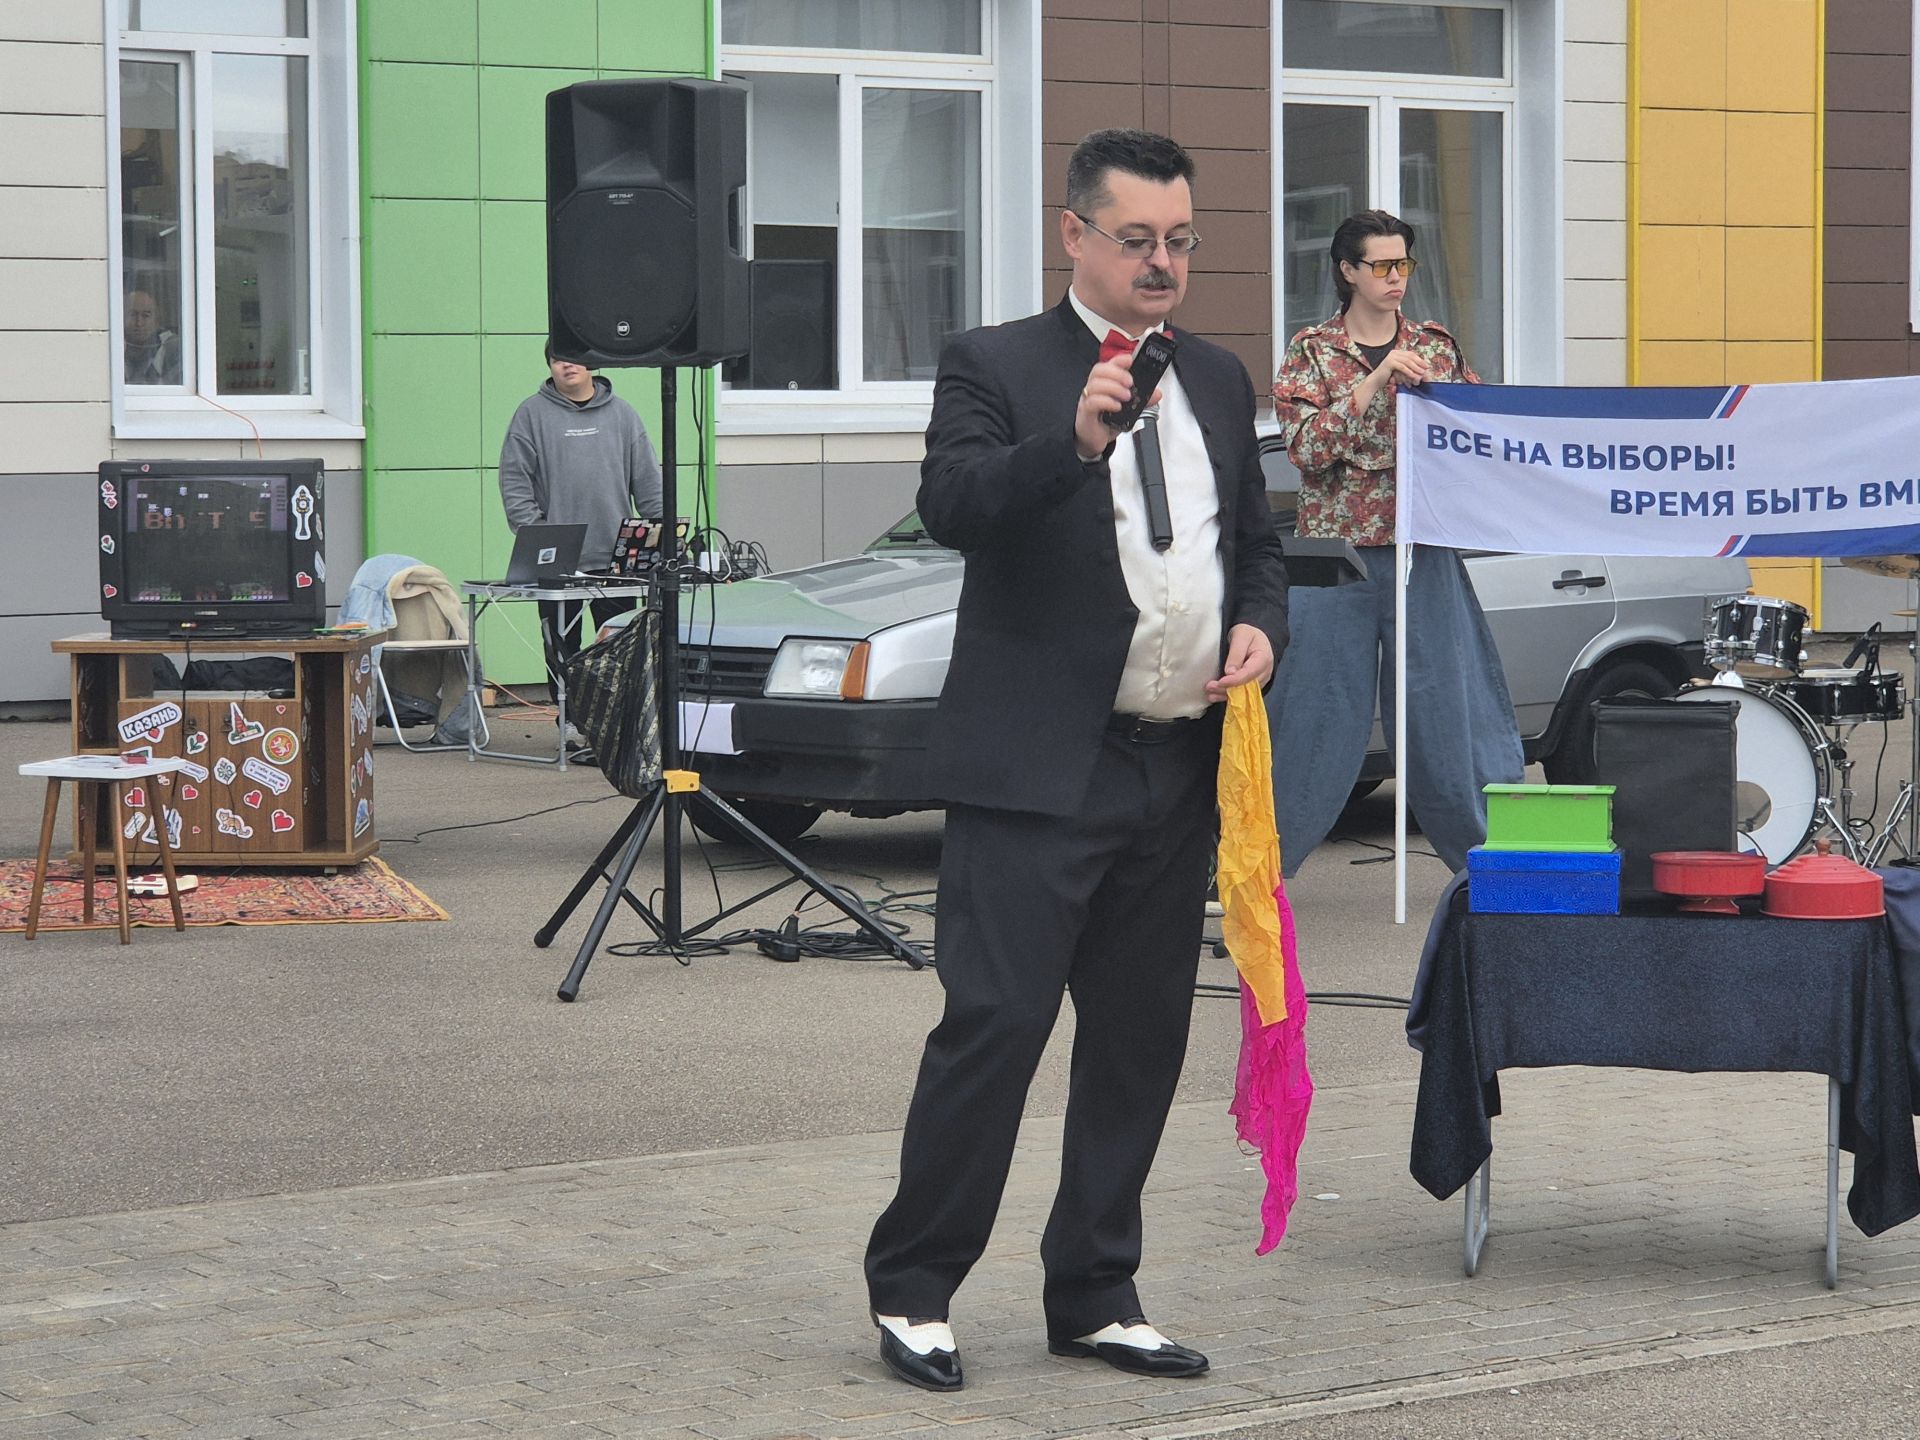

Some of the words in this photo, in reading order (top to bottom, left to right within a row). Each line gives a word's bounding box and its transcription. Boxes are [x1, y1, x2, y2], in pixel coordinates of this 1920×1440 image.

[1427, 423, 1493, 458] ВСЕ
[1503, 438, 1552, 466] НА
[1562, 443, 1735, 471] ВЫБОРЫ!
[1610, 489, 1734, 517] ВРЕМЯ
[1746, 486, 1848, 515] БЫТЬ
[1859, 479, 1920, 508] ВМ
[123, 707, 177, 739] КАЗАНЬ
